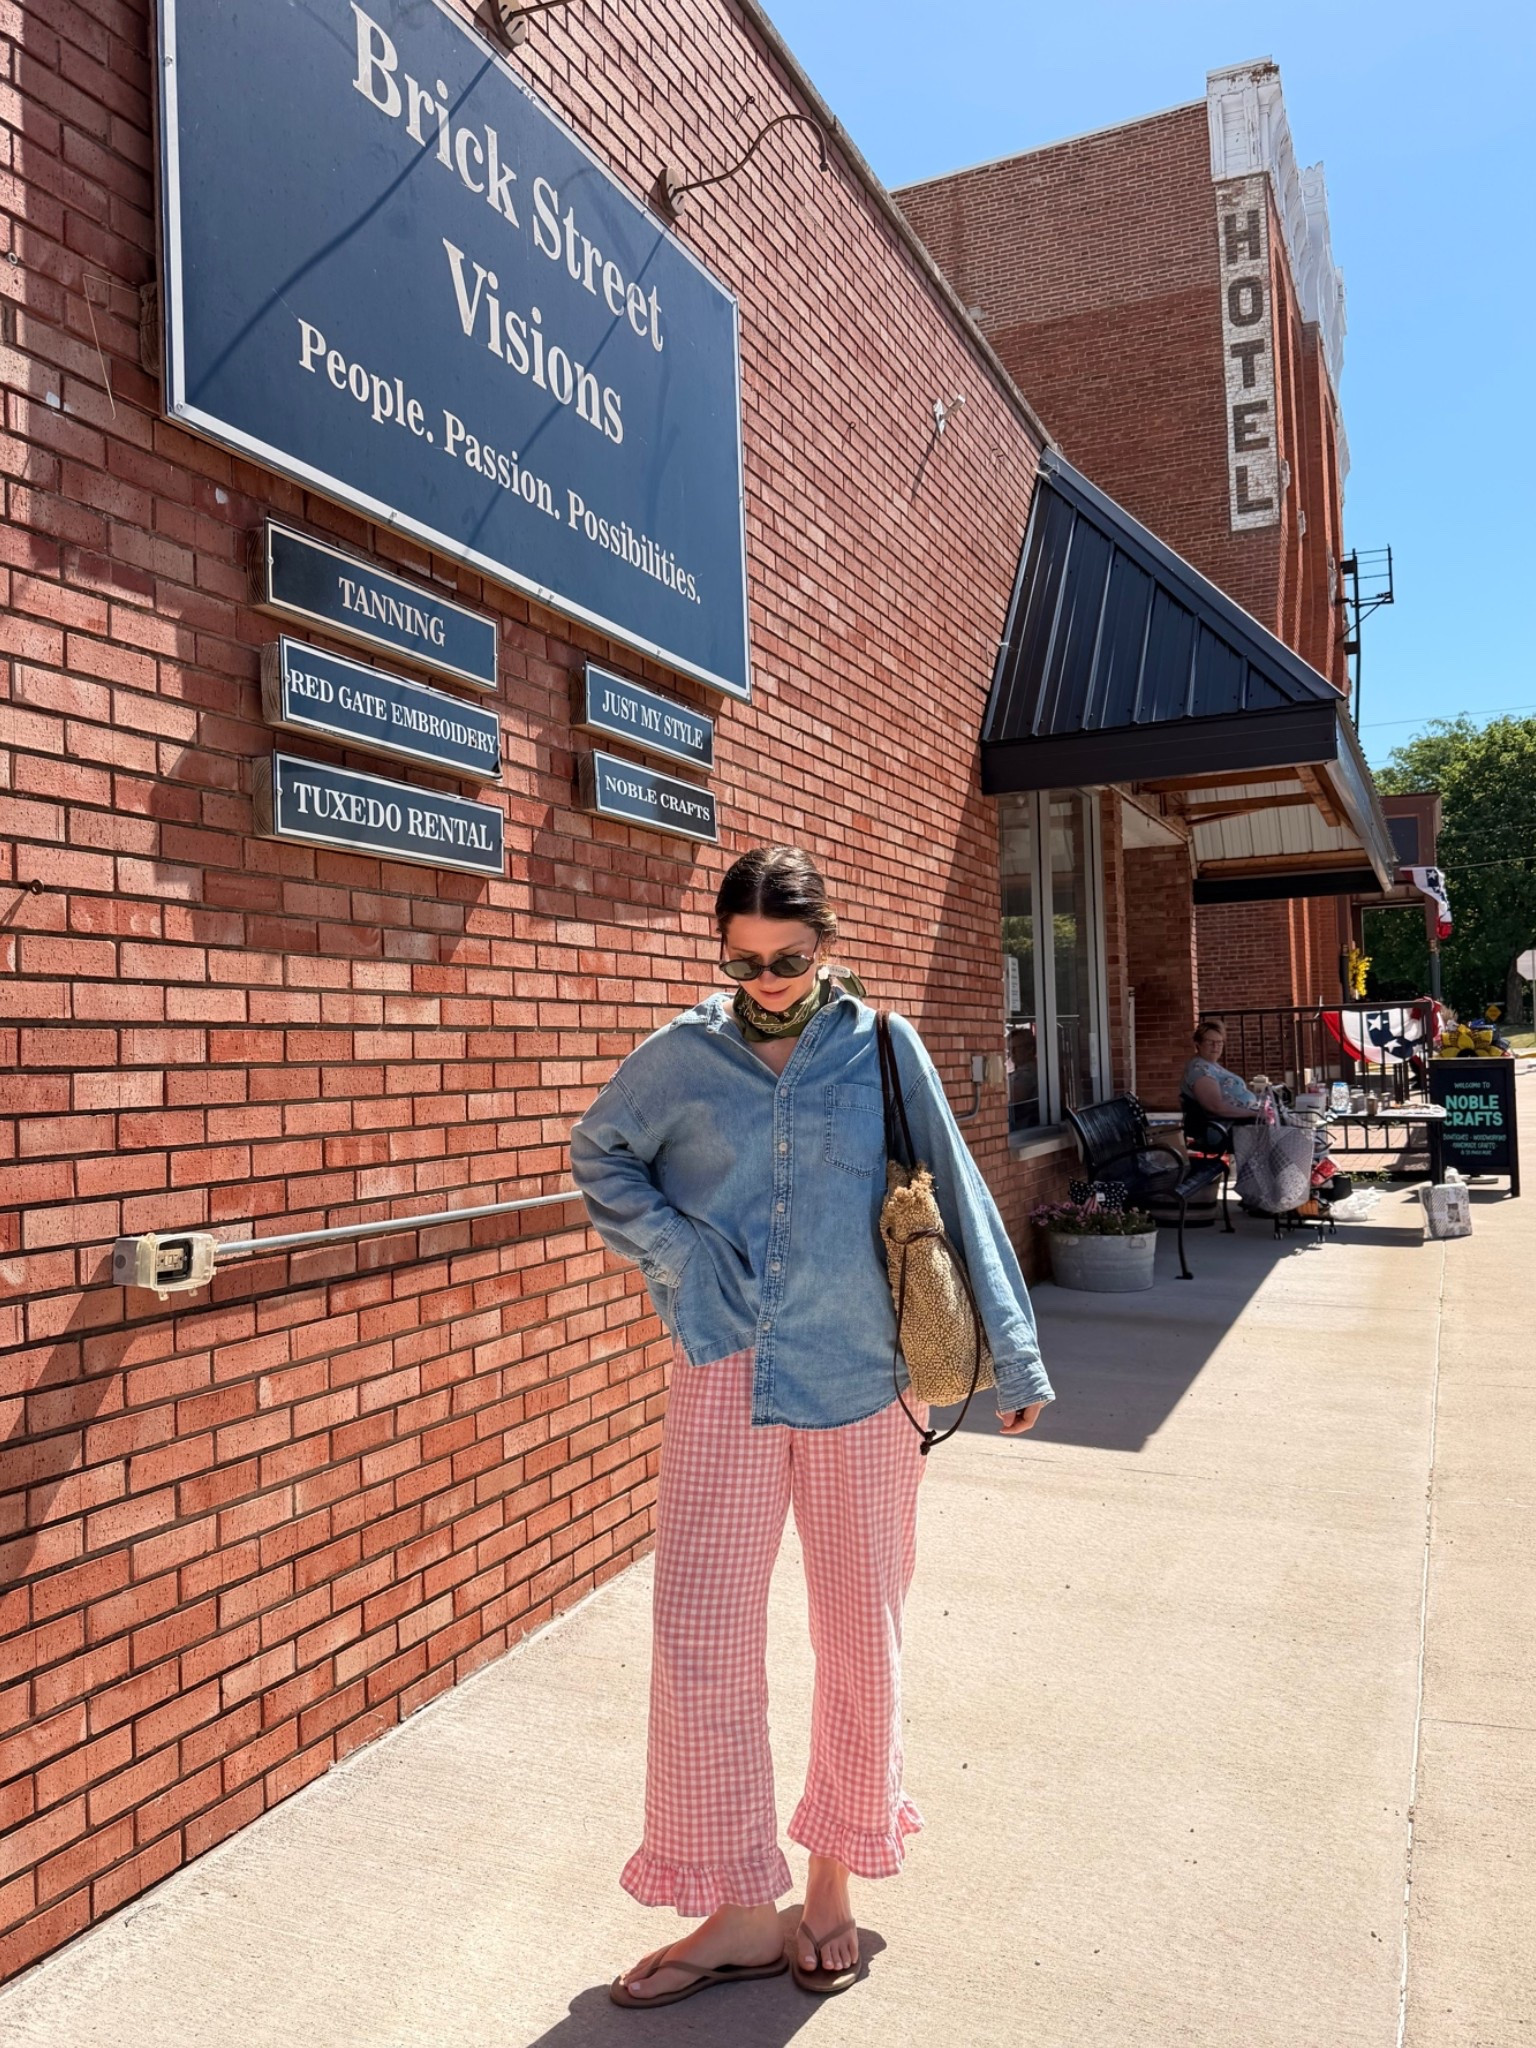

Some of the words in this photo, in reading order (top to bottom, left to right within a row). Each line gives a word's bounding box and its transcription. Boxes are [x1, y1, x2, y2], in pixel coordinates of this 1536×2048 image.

[351, 1, 519, 229] Brick
[532, 176, 664, 352] Street
[443, 238, 625, 445] Visions
[1224, 209, 1274, 515] HOTEL
[298, 318, 434, 443] People.
[443, 410, 561, 520] Passion.
[567, 489, 702, 605] Possibilities.
[338, 576, 446, 647] TANNING
[290, 669, 335, 704] RED
[338, 688, 388, 722] GATE
[391, 704, 497, 754] EMBROIDERY
[602, 690, 640, 722] JUST
[640, 705, 664, 732] MY
[664, 715, 704, 750] STYLE
[293, 782, 402, 833] TUXEDO
[407, 807, 494, 852] RENTAL
[604, 775, 658, 806] NOBLE
[660, 794, 711, 822] CRAFTS
[1443, 1111, 1503, 1126] CRAFTS
[1445, 1094, 1499, 1110] NOBLE
